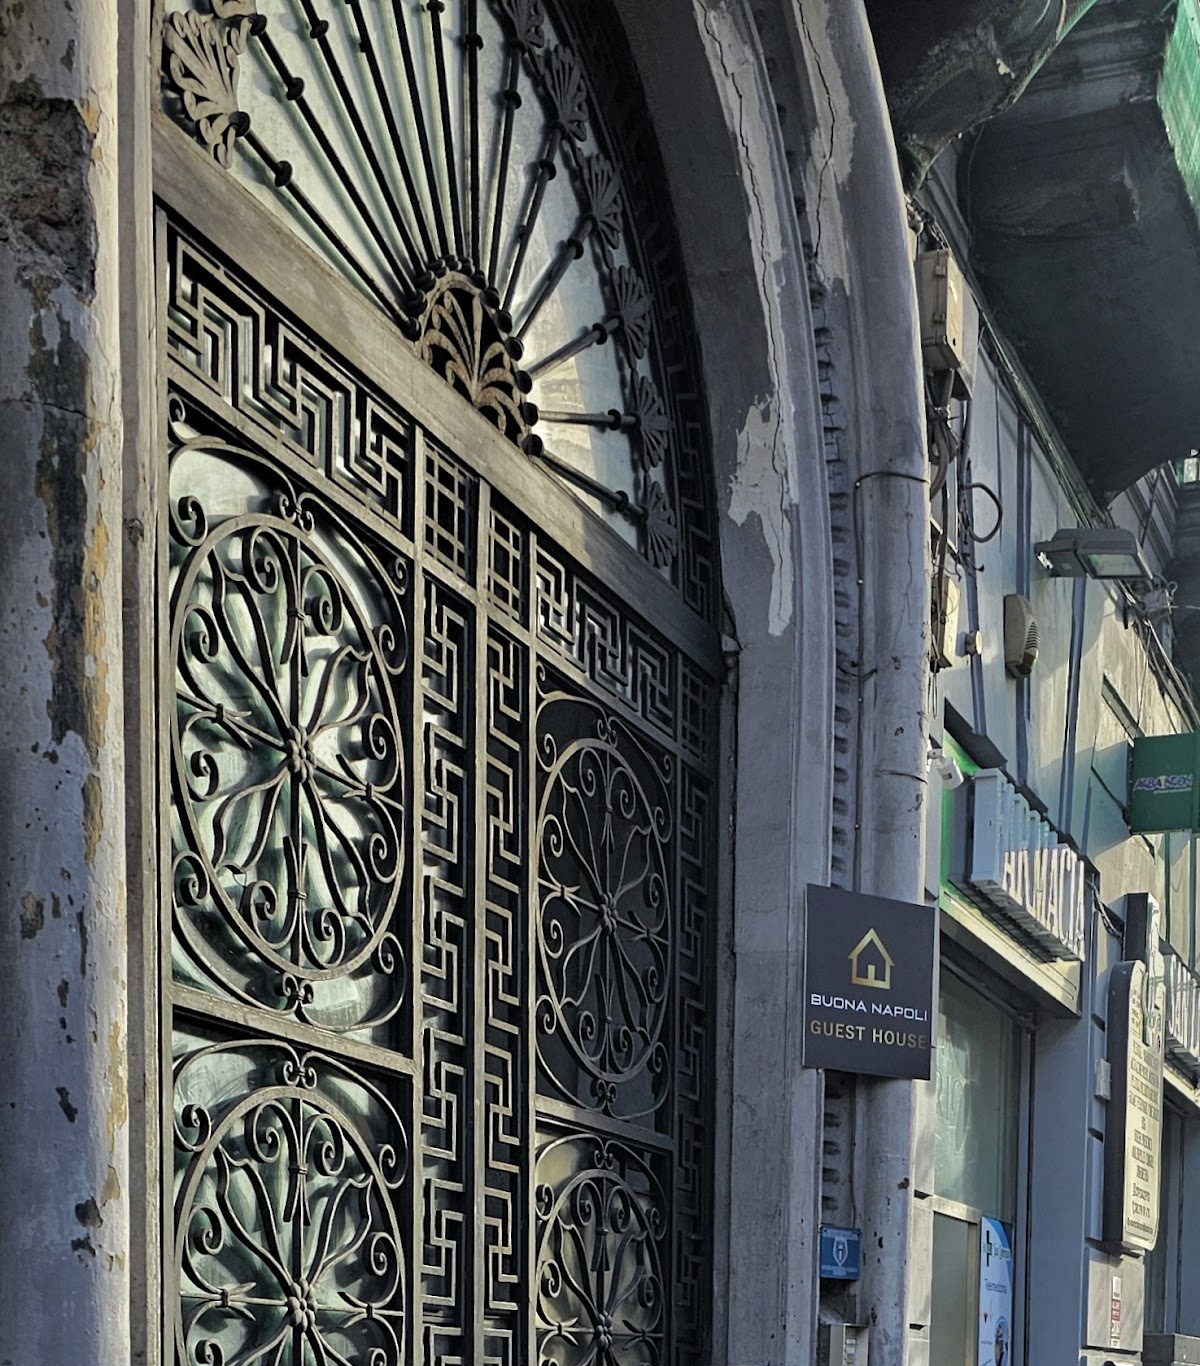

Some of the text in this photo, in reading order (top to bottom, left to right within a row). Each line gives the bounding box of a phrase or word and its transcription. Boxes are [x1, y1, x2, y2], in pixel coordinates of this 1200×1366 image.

[811, 993, 928, 1021] BUONA NAPOLI
[810, 1020, 928, 1049] GUEST HOUSE
